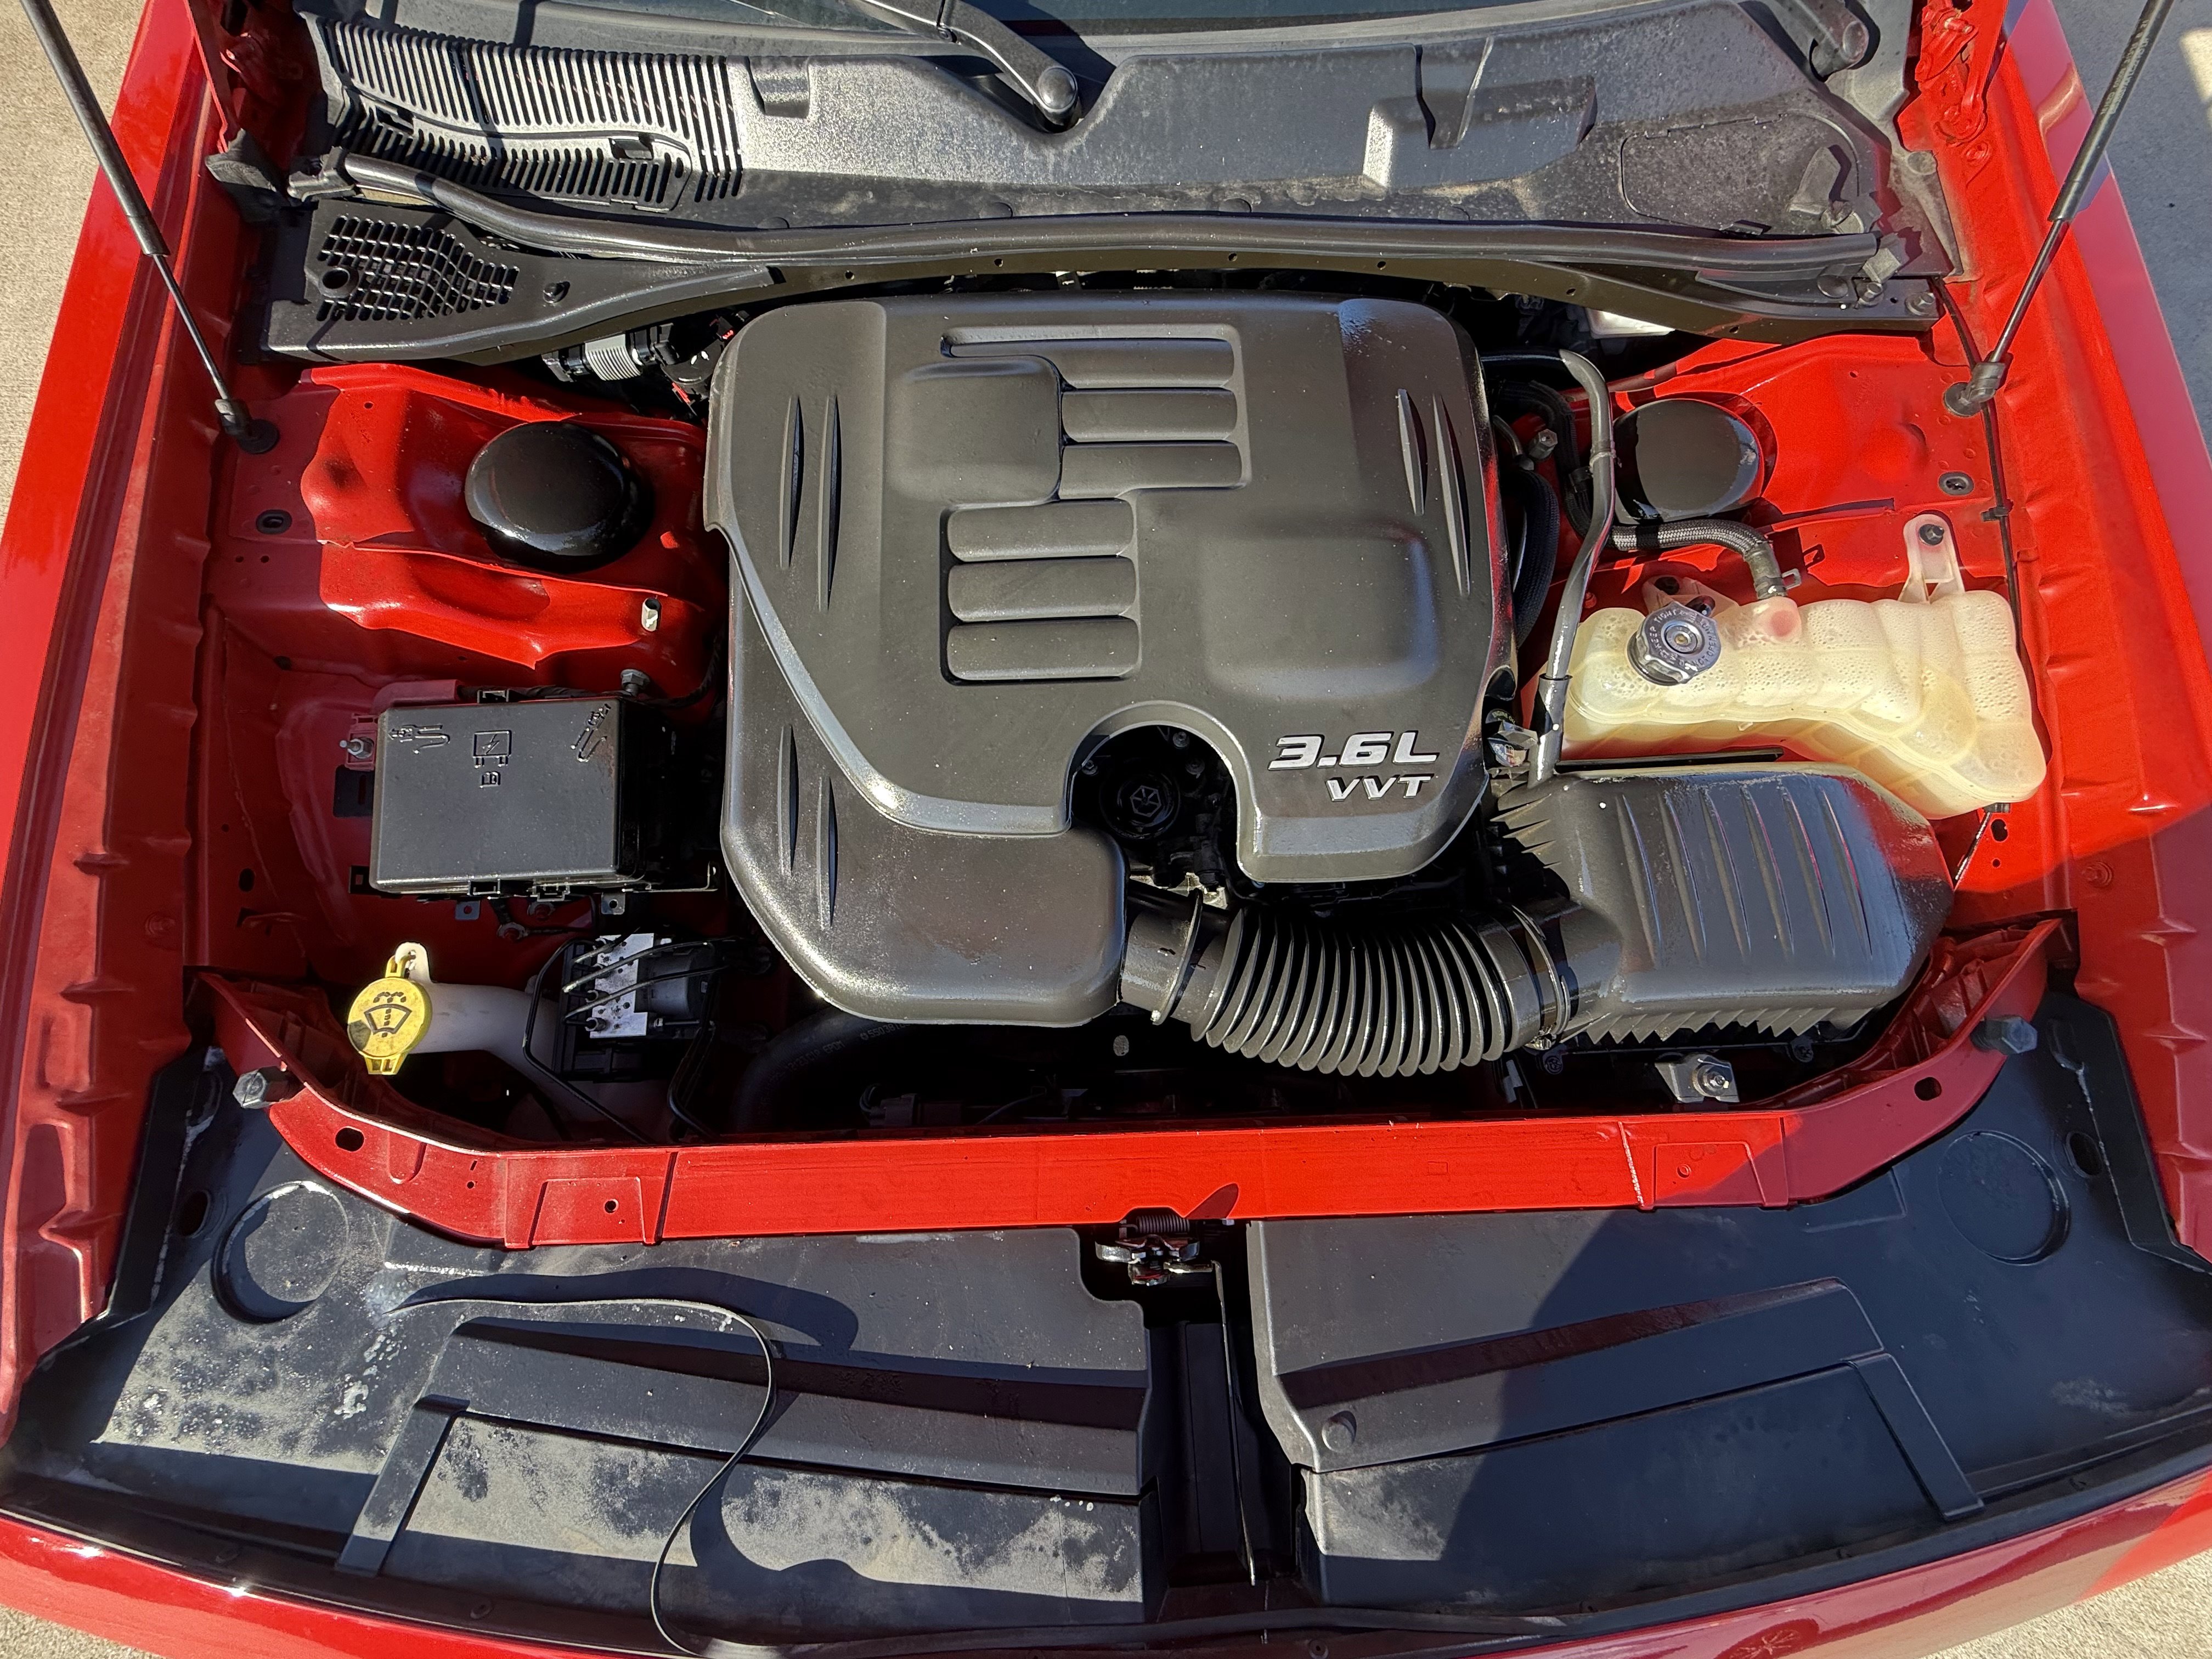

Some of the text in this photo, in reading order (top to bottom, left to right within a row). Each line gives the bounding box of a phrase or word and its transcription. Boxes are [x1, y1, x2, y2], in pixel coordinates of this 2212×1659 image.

[1650, 609, 1677, 650] KEEP TIGHT
[1268, 731, 1438, 771] 3.6L
[1326, 774, 1433, 802] VVT
[823, 1040, 845, 1054] EPDM
